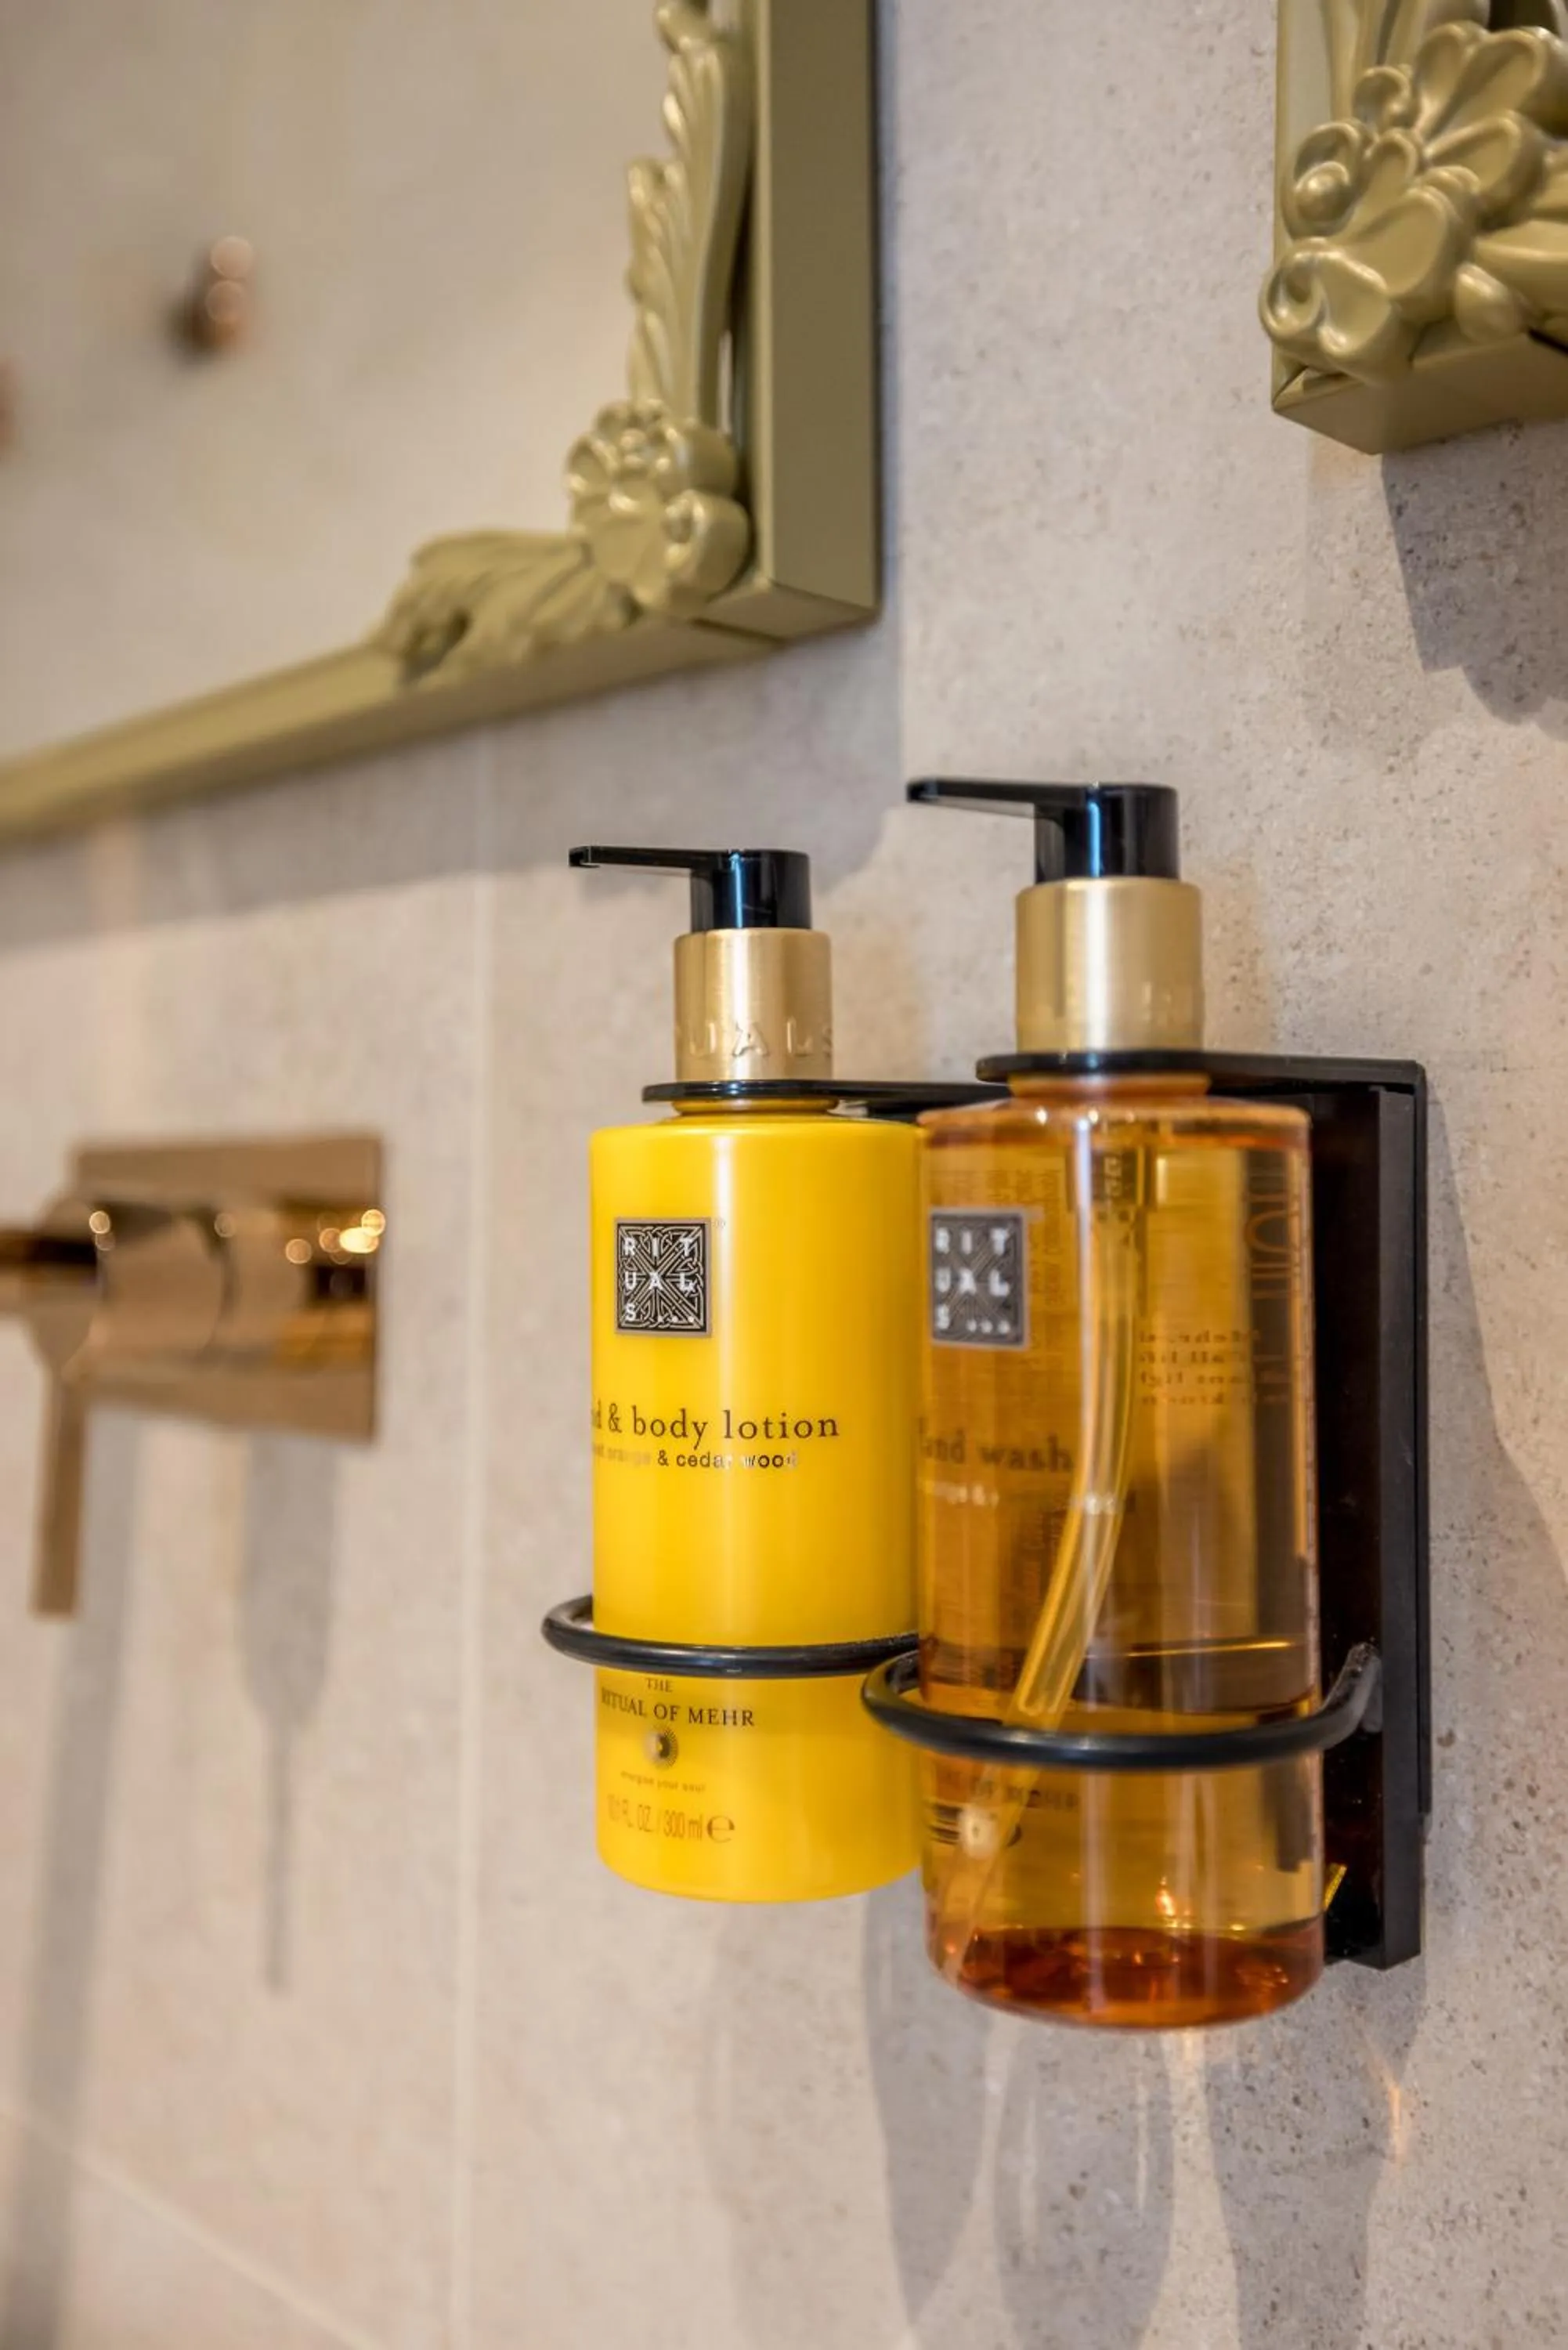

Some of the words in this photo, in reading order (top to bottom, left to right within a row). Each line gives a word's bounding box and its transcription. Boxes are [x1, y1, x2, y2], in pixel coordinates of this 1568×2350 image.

[609, 1403, 623, 1434] &
[631, 1405, 708, 1450] body
[722, 1409, 840, 1439] lotion
[657, 1450, 669, 1466] &
[646, 1678, 673, 1693] THE
[653, 1703, 681, 1721] OF
[688, 1707, 755, 1726] MEHR
